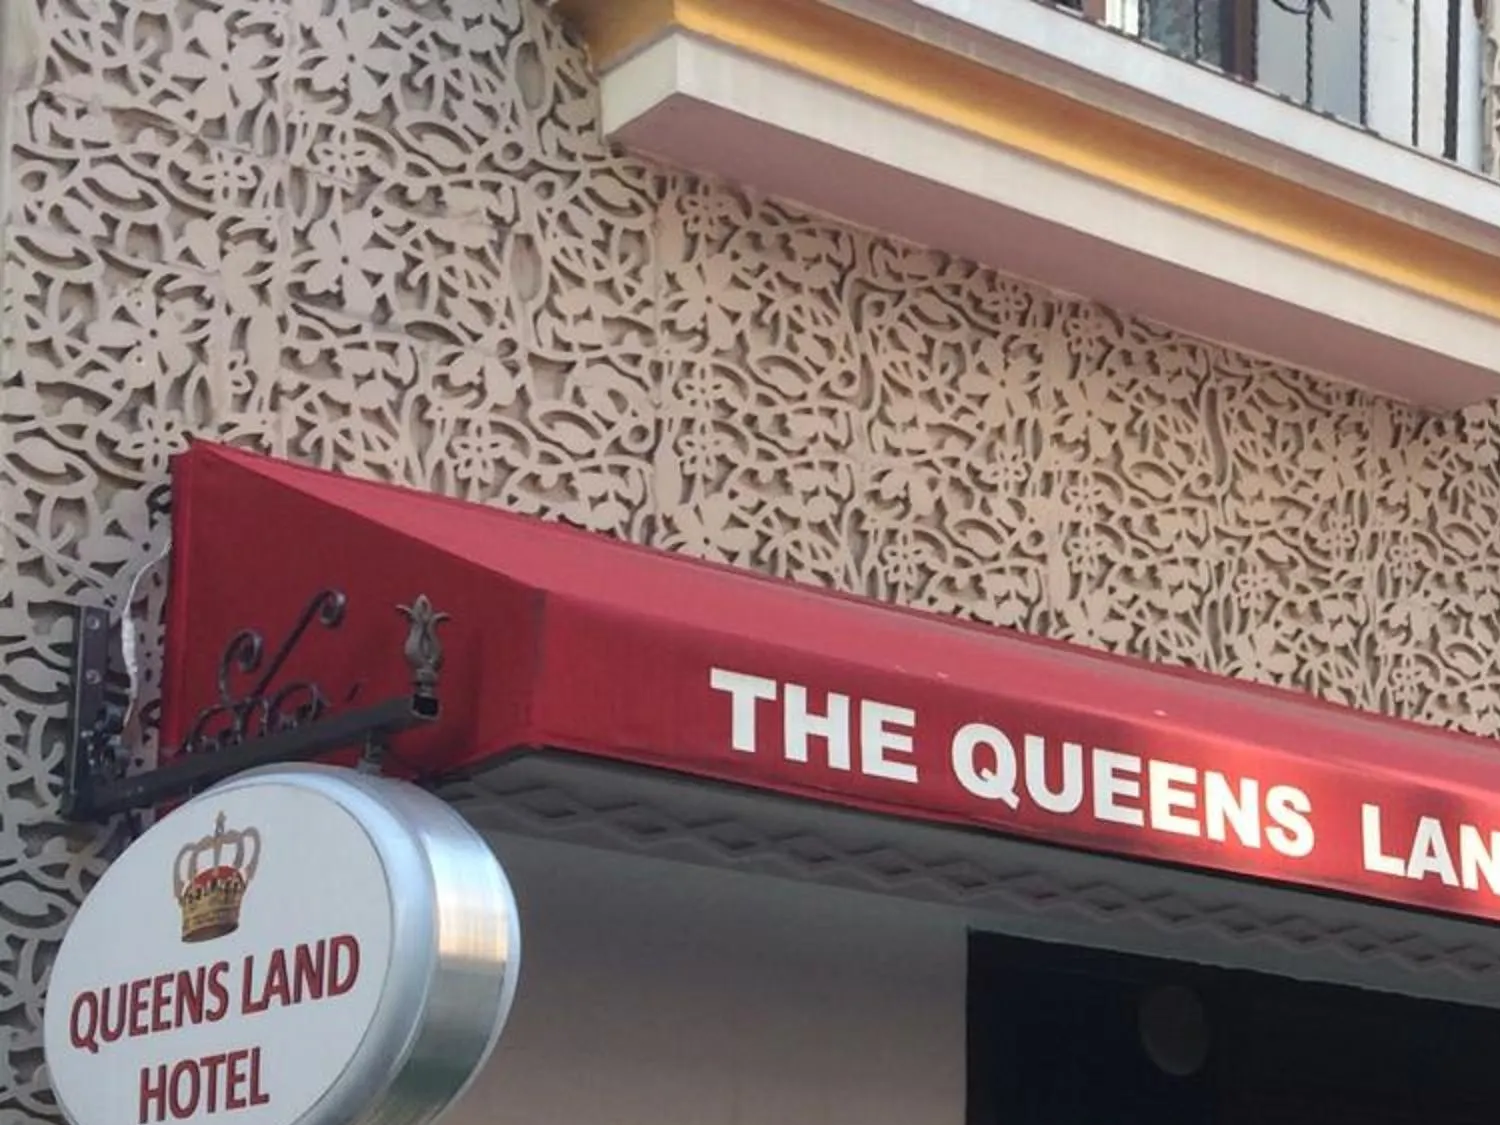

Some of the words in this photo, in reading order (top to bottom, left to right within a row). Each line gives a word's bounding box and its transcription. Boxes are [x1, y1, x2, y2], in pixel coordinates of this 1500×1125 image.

[710, 666, 918, 783] THE
[951, 723, 1315, 857] QUEENS
[69, 961, 229, 1054] QUEENS
[241, 934, 360, 1015] LAND
[139, 1047, 270, 1124] HOTEL
